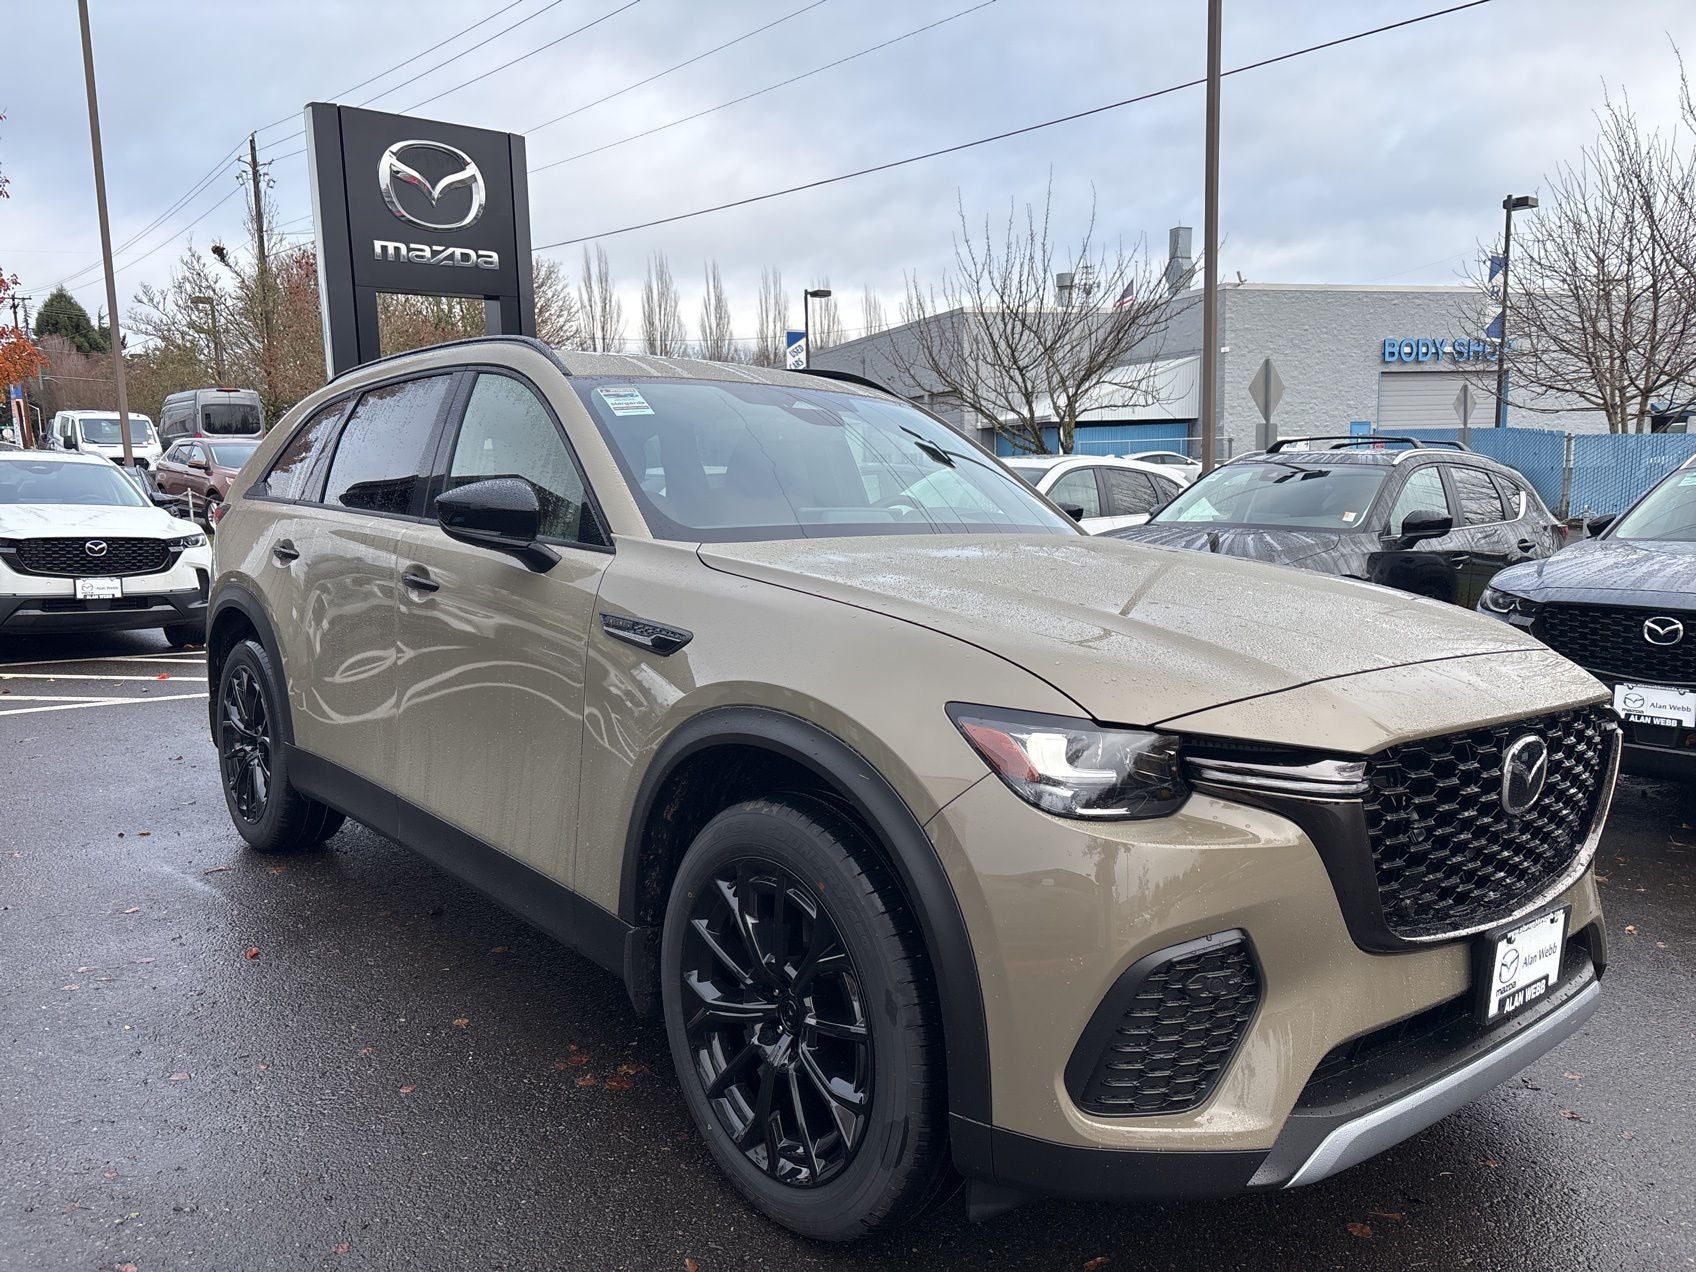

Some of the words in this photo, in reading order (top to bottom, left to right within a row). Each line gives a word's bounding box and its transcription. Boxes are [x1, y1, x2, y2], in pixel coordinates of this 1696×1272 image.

[789, 344, 805, 358] USED
[1383, 339, 1446, 361] BODY
[1650, 702, 1667, 710] Alan
[1669, 704, 1692, 713] Webb
[1629, 714, 1651, 724] ALAN
[1653, 717, 1678, 727] WEBB
[1522, 955, 1538, 969] Alan
[1538, 942, 1558, 961] Webb
[1503, 990, 1525, 1014] ALAN
[1525, 978, 1546, 1002] WEBB
